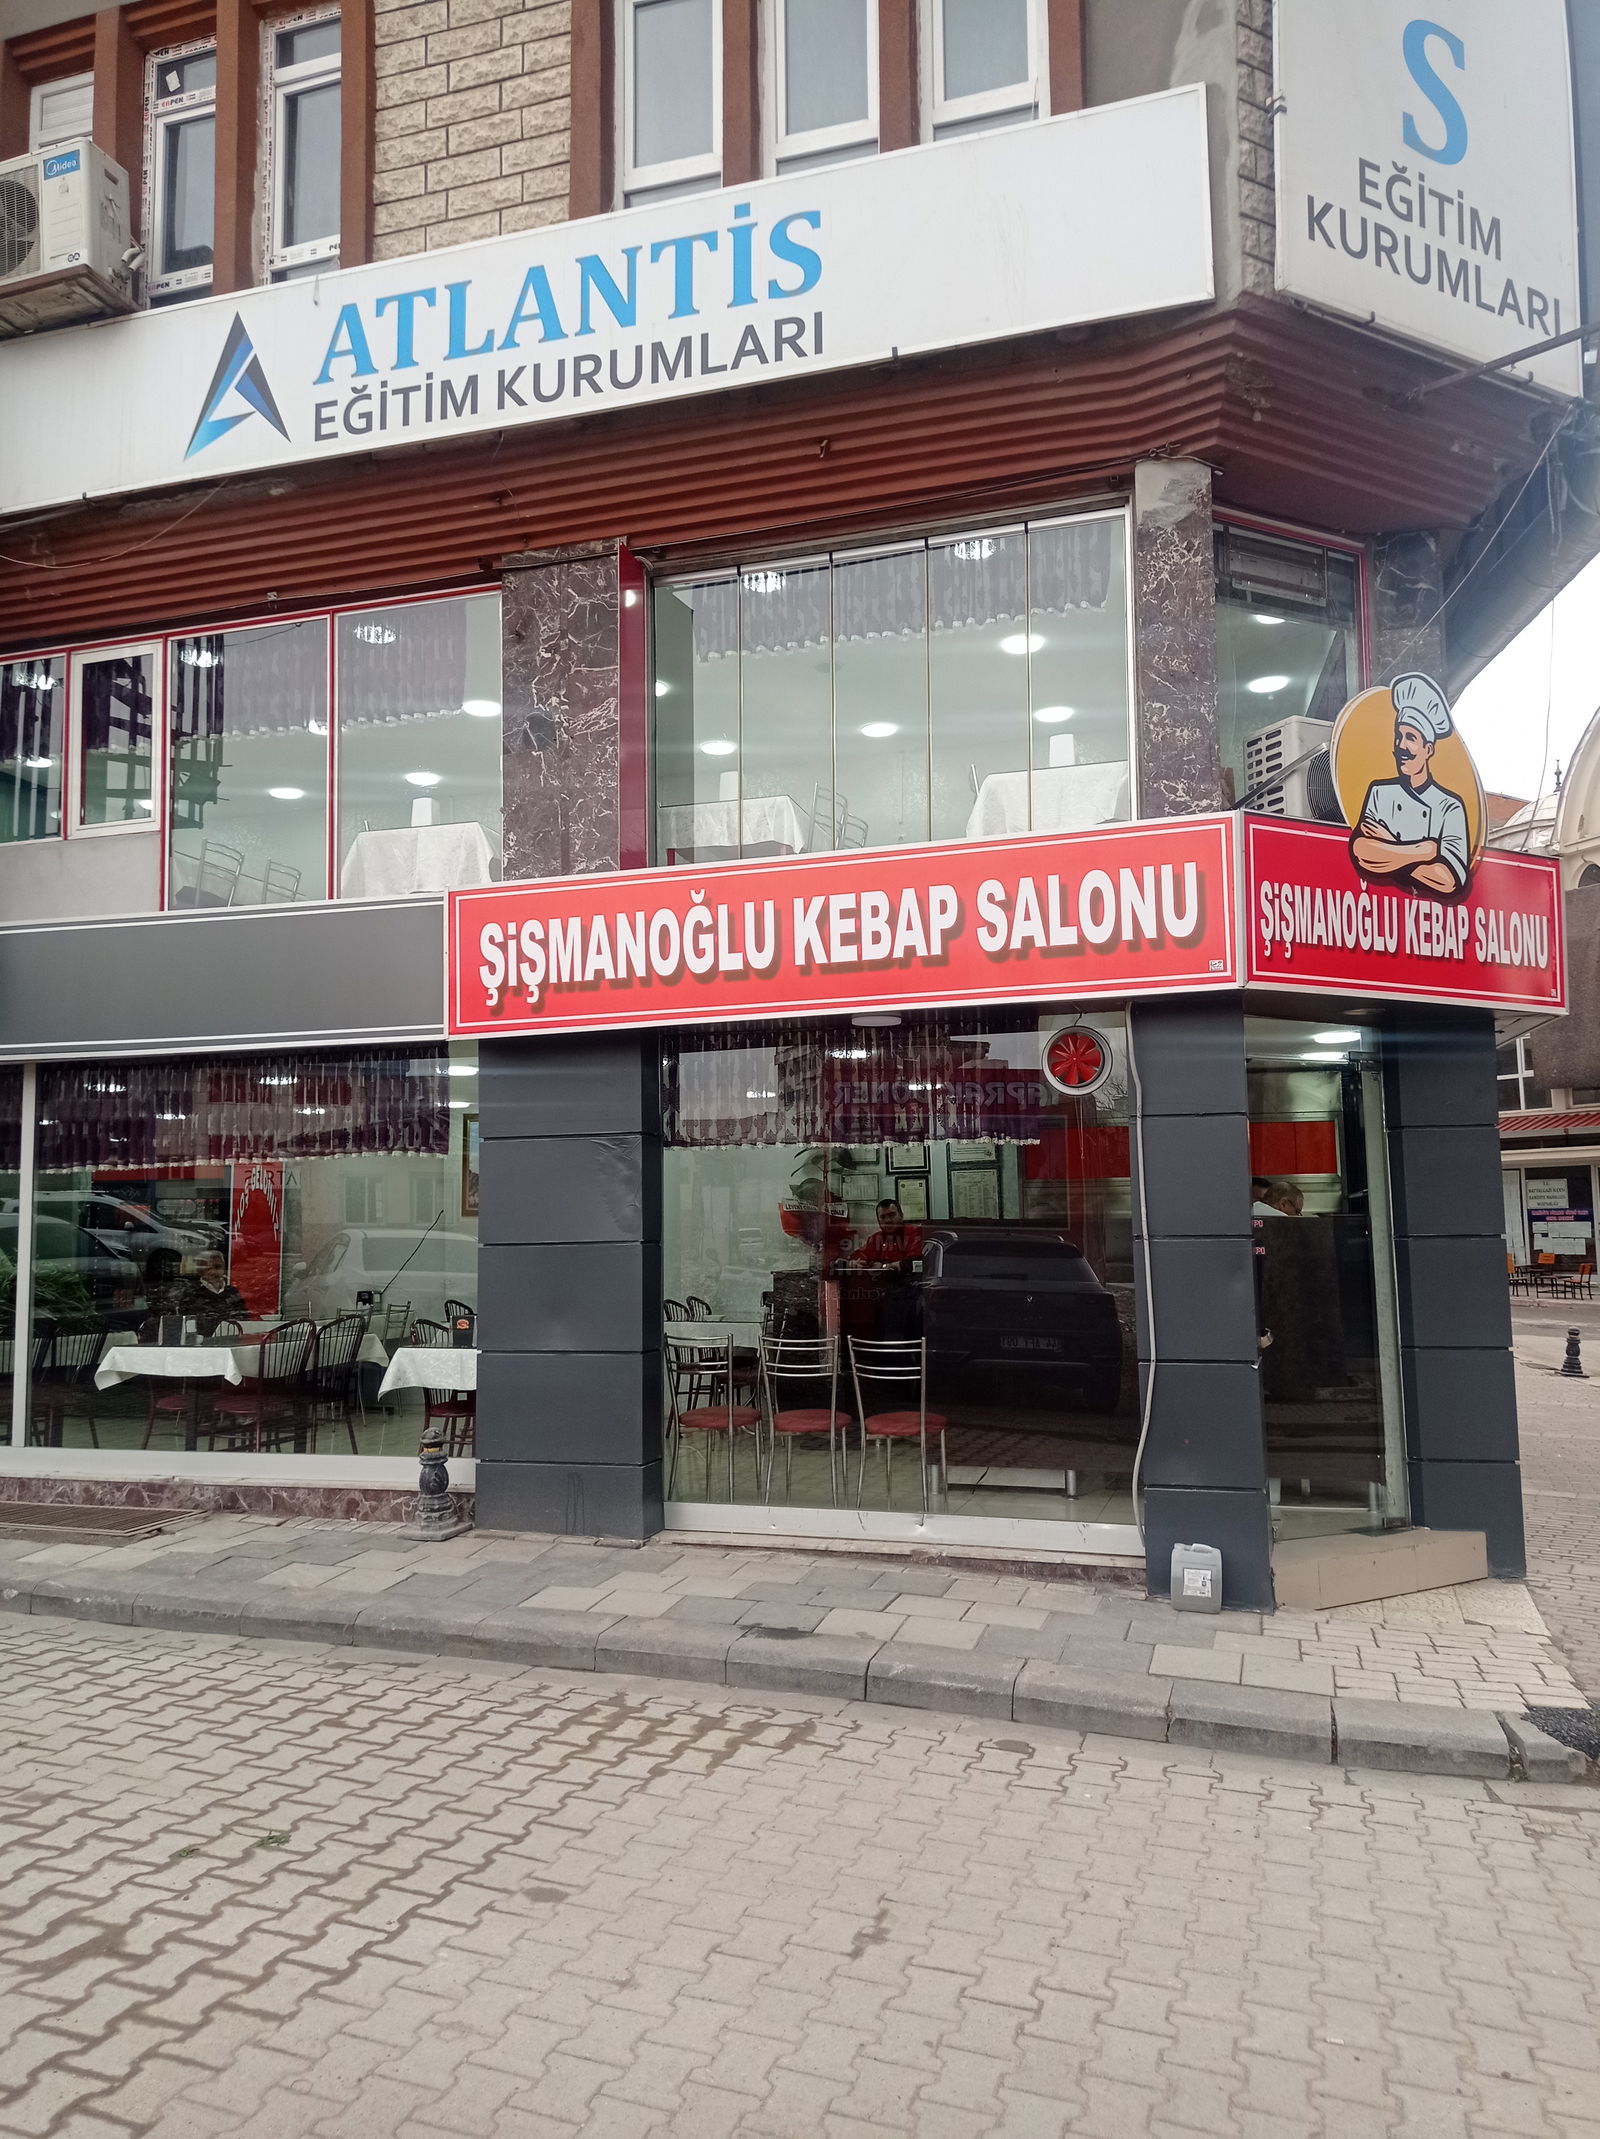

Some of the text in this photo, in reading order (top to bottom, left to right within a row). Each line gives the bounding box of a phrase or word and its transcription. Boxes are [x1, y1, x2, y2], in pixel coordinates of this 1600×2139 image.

[1402, 19, 1468, 165] S
[47, 159, 77, 176] Midea
[1358, 157, 1503, 262] EĞİTİM
[312, 202, 822, 386] ATLANTİS
[1306, 195, 1560, 338] KURUMLARI
[313, 311, 824, 442] EĞİTİM KURUMLARI
[792, 884, 960, 968] KEBAP
[976, 861, 1200, 954] SALONU
[1404, 898, 1470, 961] KEBAP
[1474, 907, 1549, 970] SALONU
